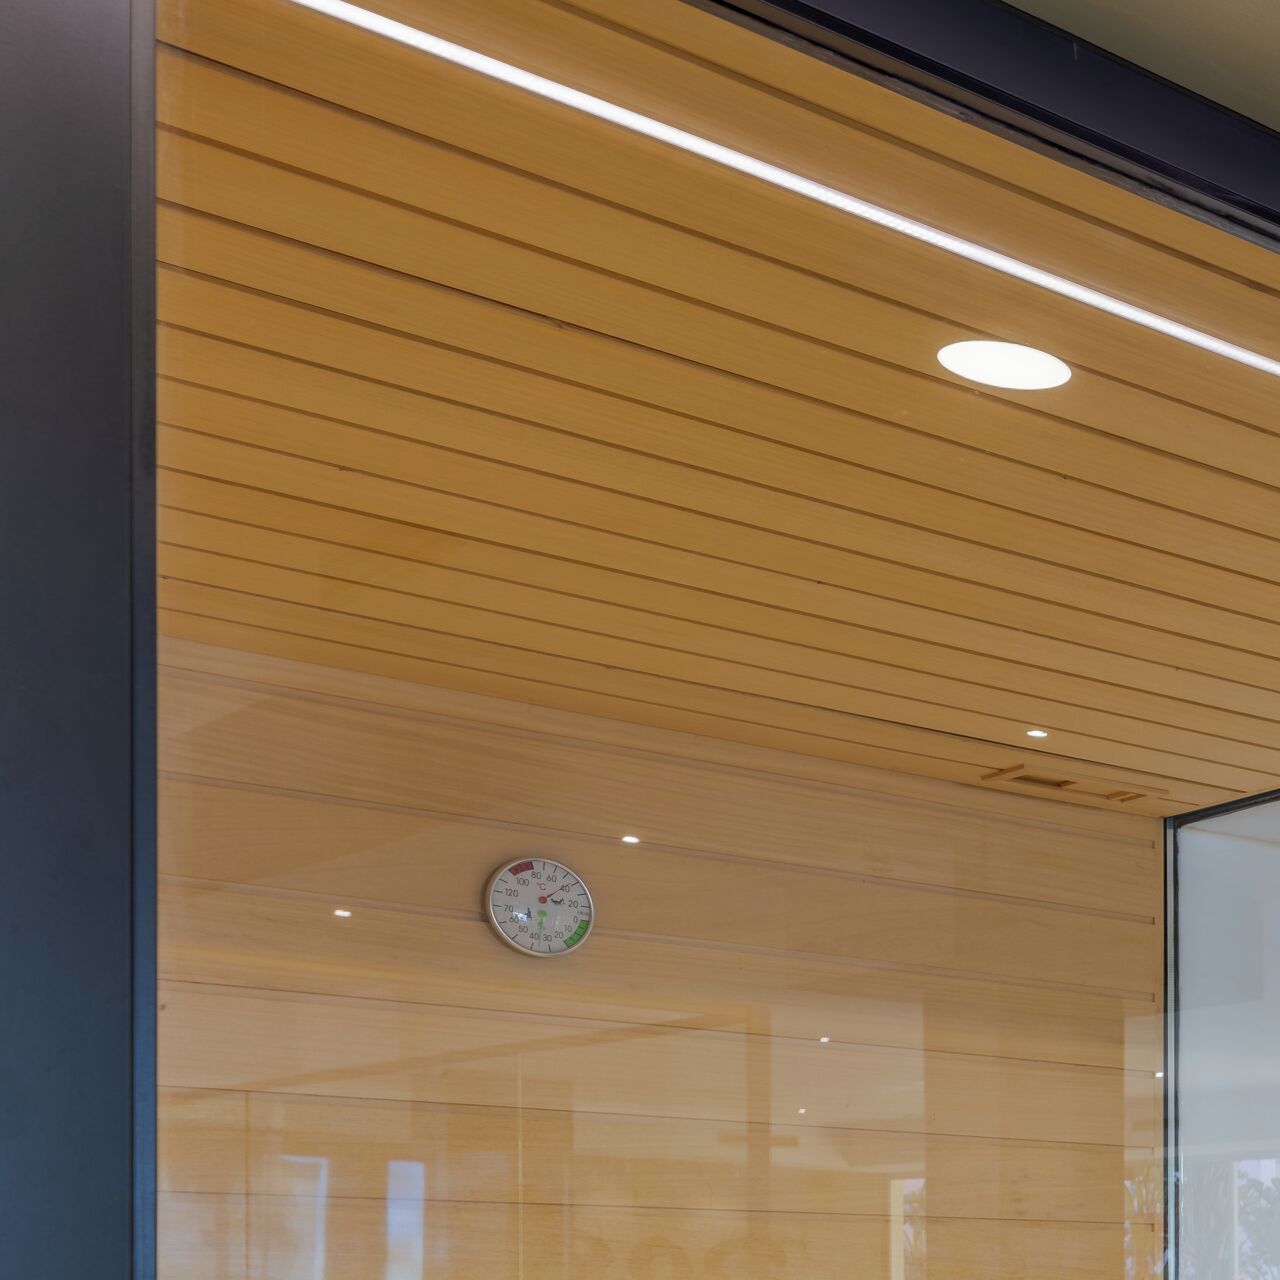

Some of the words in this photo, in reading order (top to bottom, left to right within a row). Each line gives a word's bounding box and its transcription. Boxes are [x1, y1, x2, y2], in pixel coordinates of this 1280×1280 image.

[531, 871, 542, 879] 80
[546, 875, 557, 883] 60
[516, 877, 530, 887] 100
[505, 888, 519, 897] 120
[561, 885, 571, 893] 40
[568, 900, 579, 908] 20
[509, 916, 519, 924] 60
[573, 915, 578, 923] 0
[518, 925, 528, 933] 50
[564, 925, 573, 933] 10
[529, 932, 539, 940] 40
[542, 934, 552, 942] 30
[554, 931, 564, 939] 20
